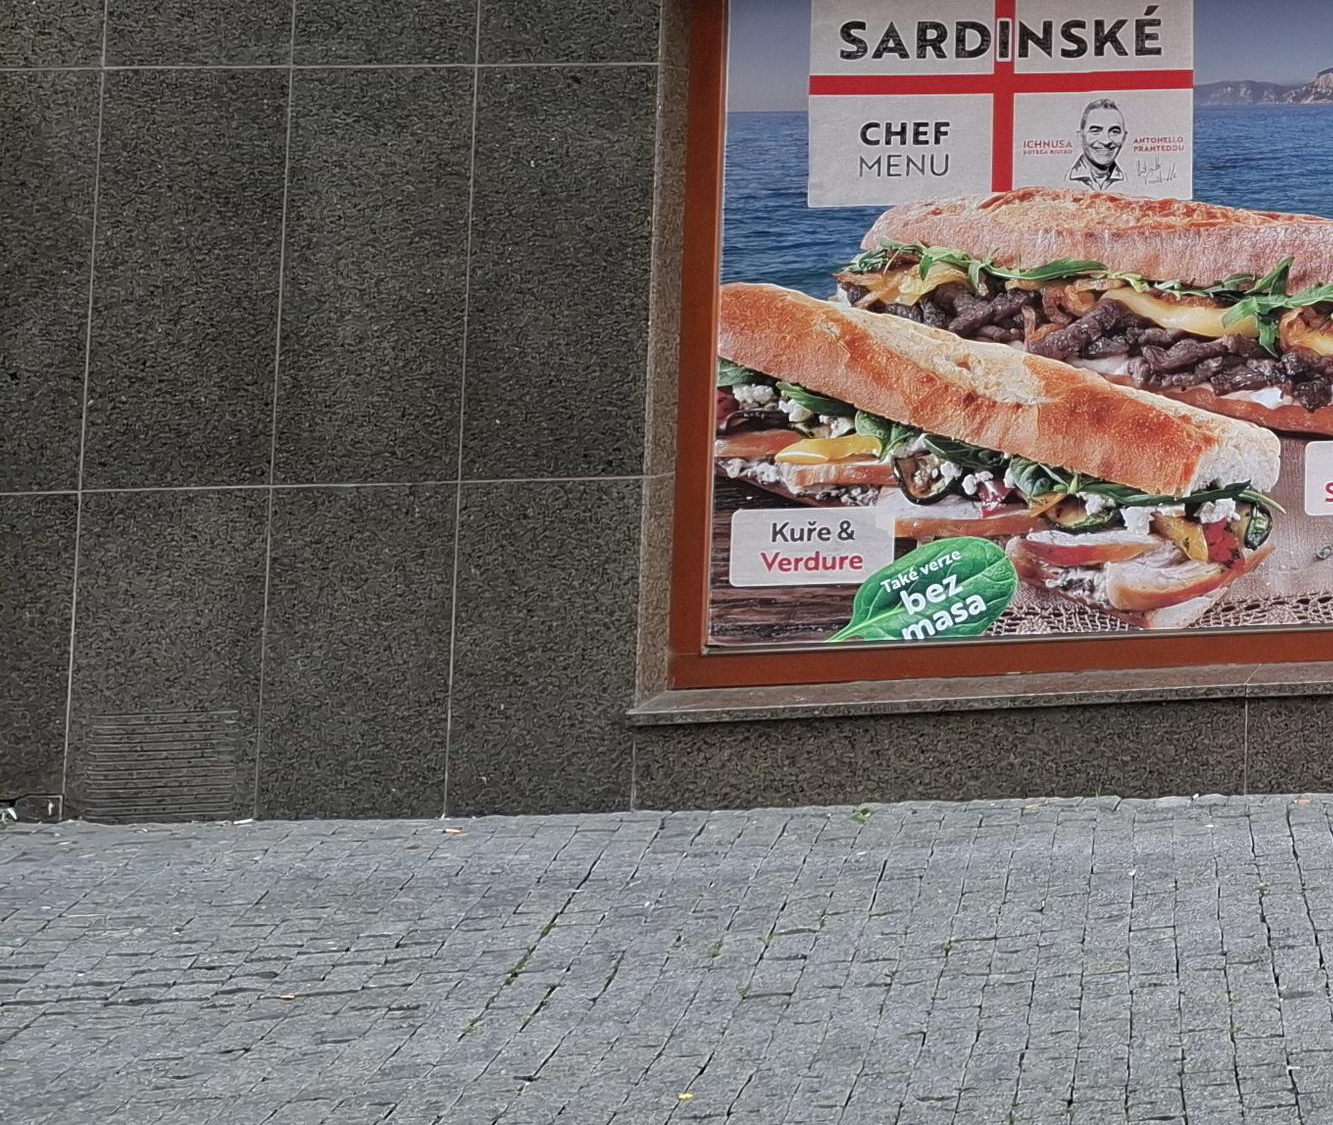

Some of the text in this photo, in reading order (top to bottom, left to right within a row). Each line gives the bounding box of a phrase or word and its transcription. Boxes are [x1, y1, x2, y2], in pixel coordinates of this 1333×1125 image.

[839, 5, 1163, 60] SARDINSKÉ
[859, 121, 950, 146] CHEF
[1023, 139, 1073, 149] ICHNUSA
[859, 153, 950, 177] MENU
[771, 520, 856, 543] Kuře &
[761, 552, 863, 573] Verdure
[880, 550, 961, 593] Také verze
[900, 574, 963, 615] bez
[901, 594, 987, 640] masa
